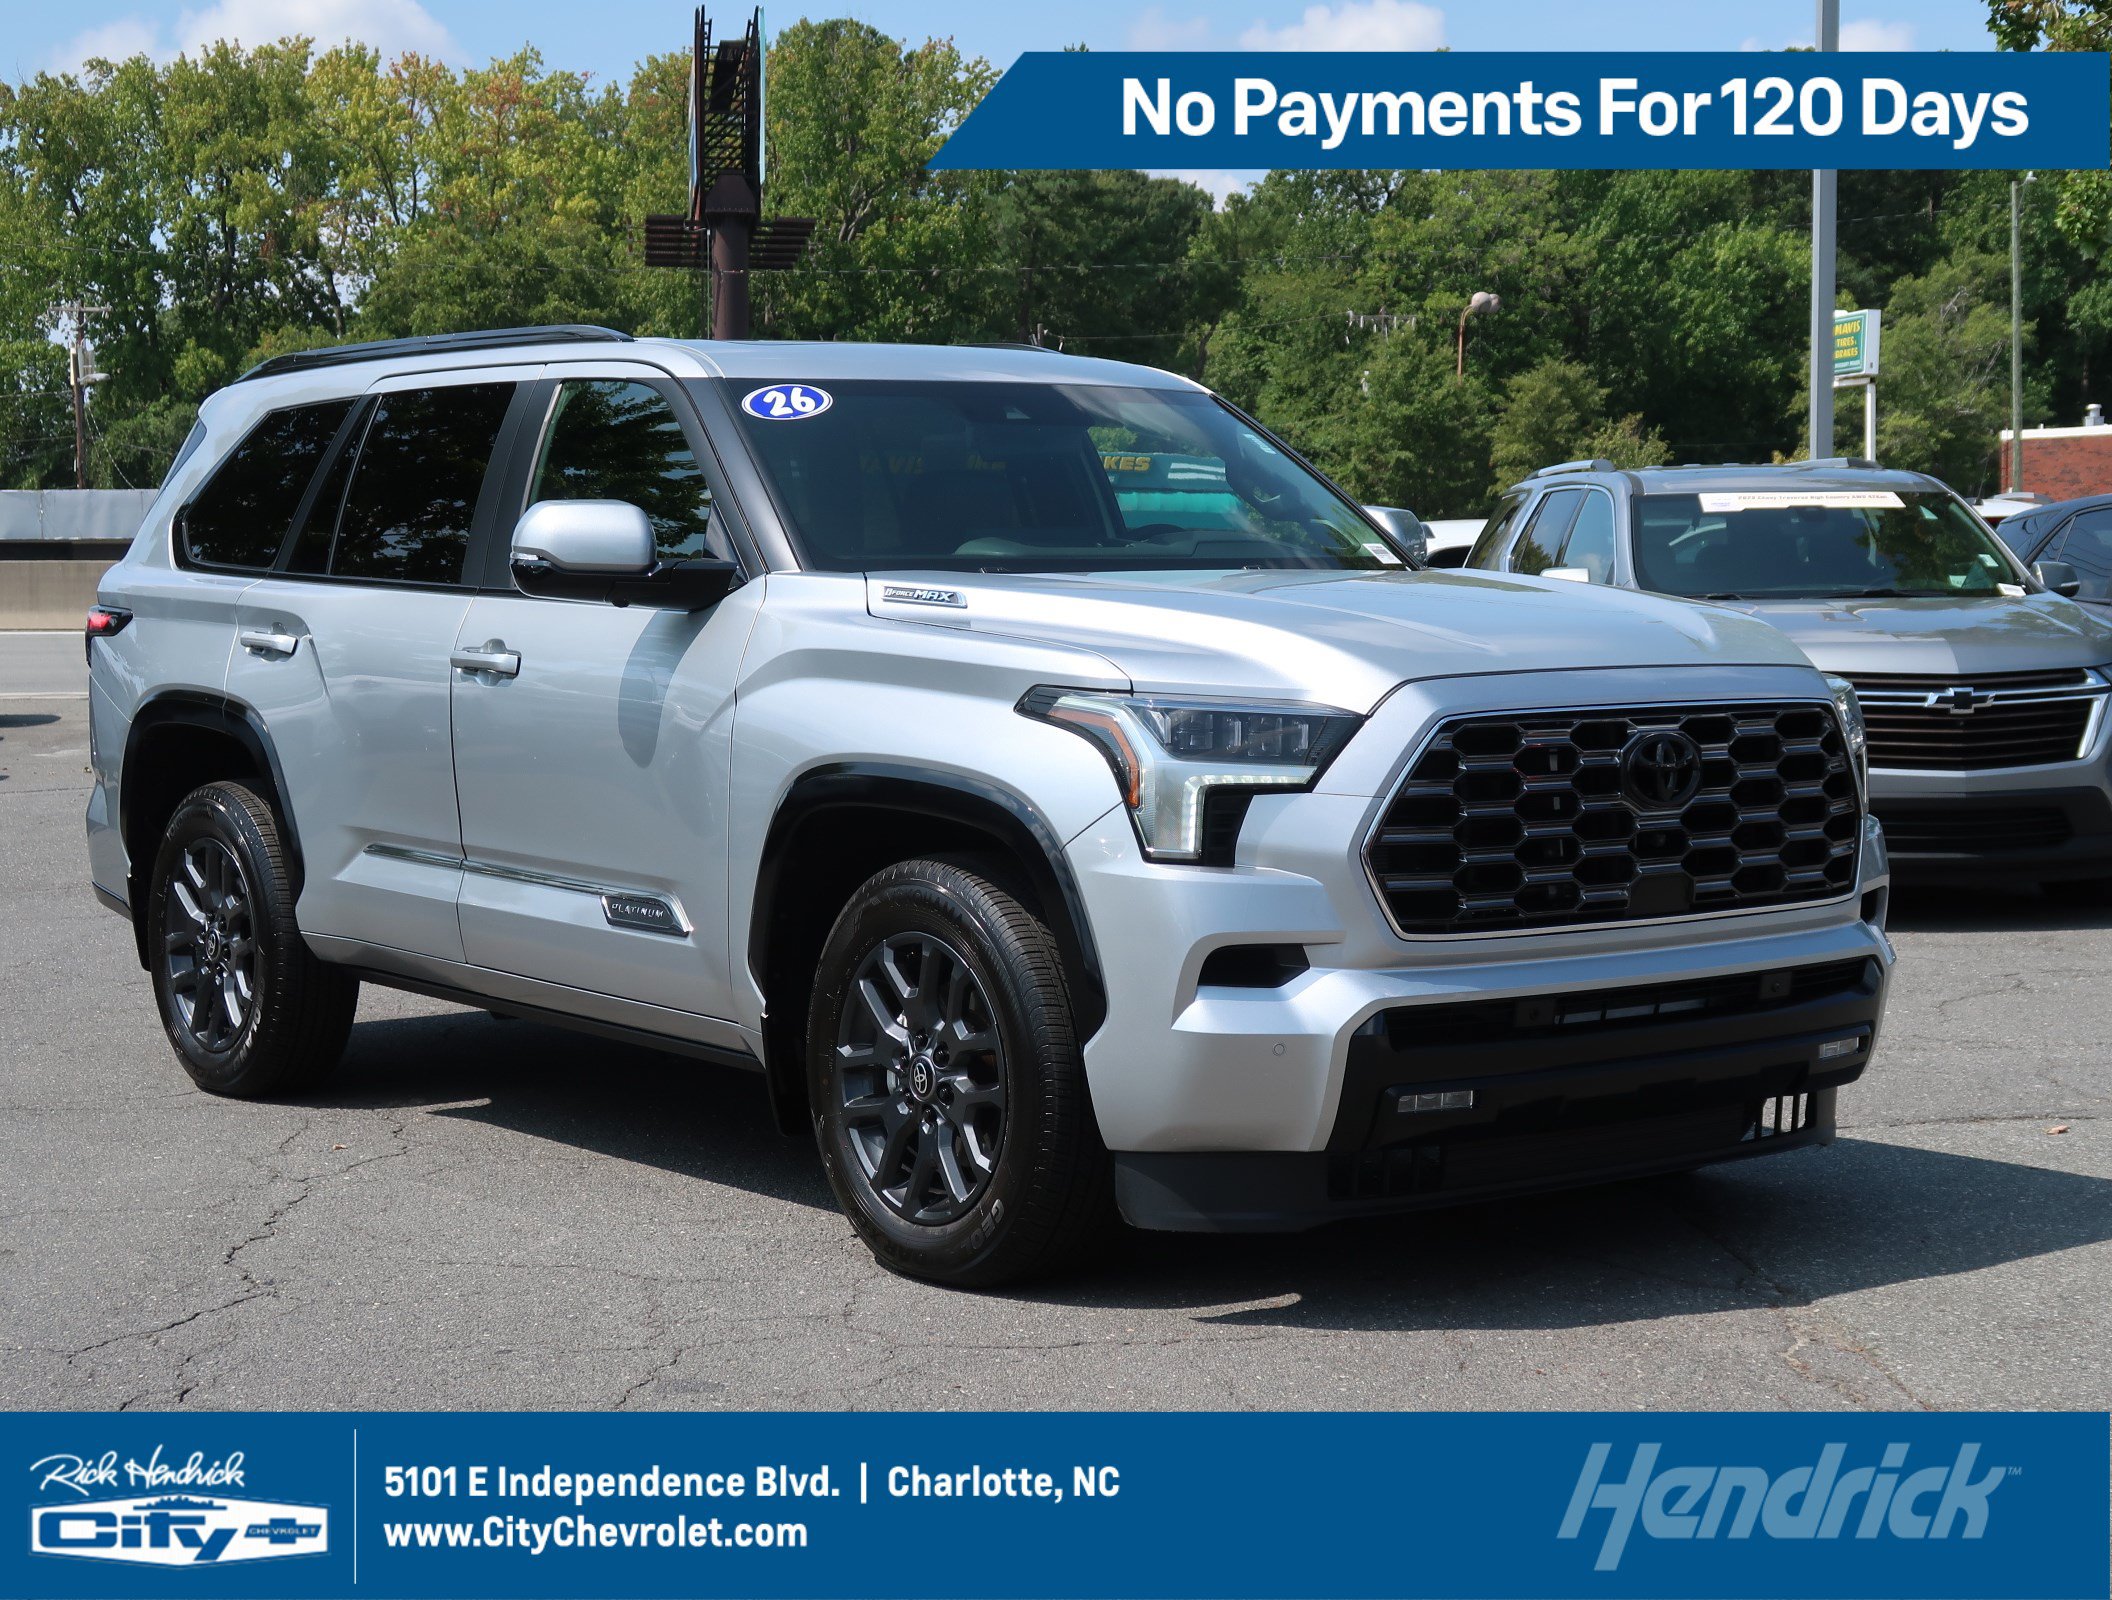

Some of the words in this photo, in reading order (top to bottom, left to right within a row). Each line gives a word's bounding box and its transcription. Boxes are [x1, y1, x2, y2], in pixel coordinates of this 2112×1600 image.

[1834, 320, 1861, 336] MAVIS
[763, 387, 816, 416] 26
[1102, 455, 1152, 472] KES
[913, 589, 954, 602] MAX
[611, 903, 664, 918] PLATINUM
